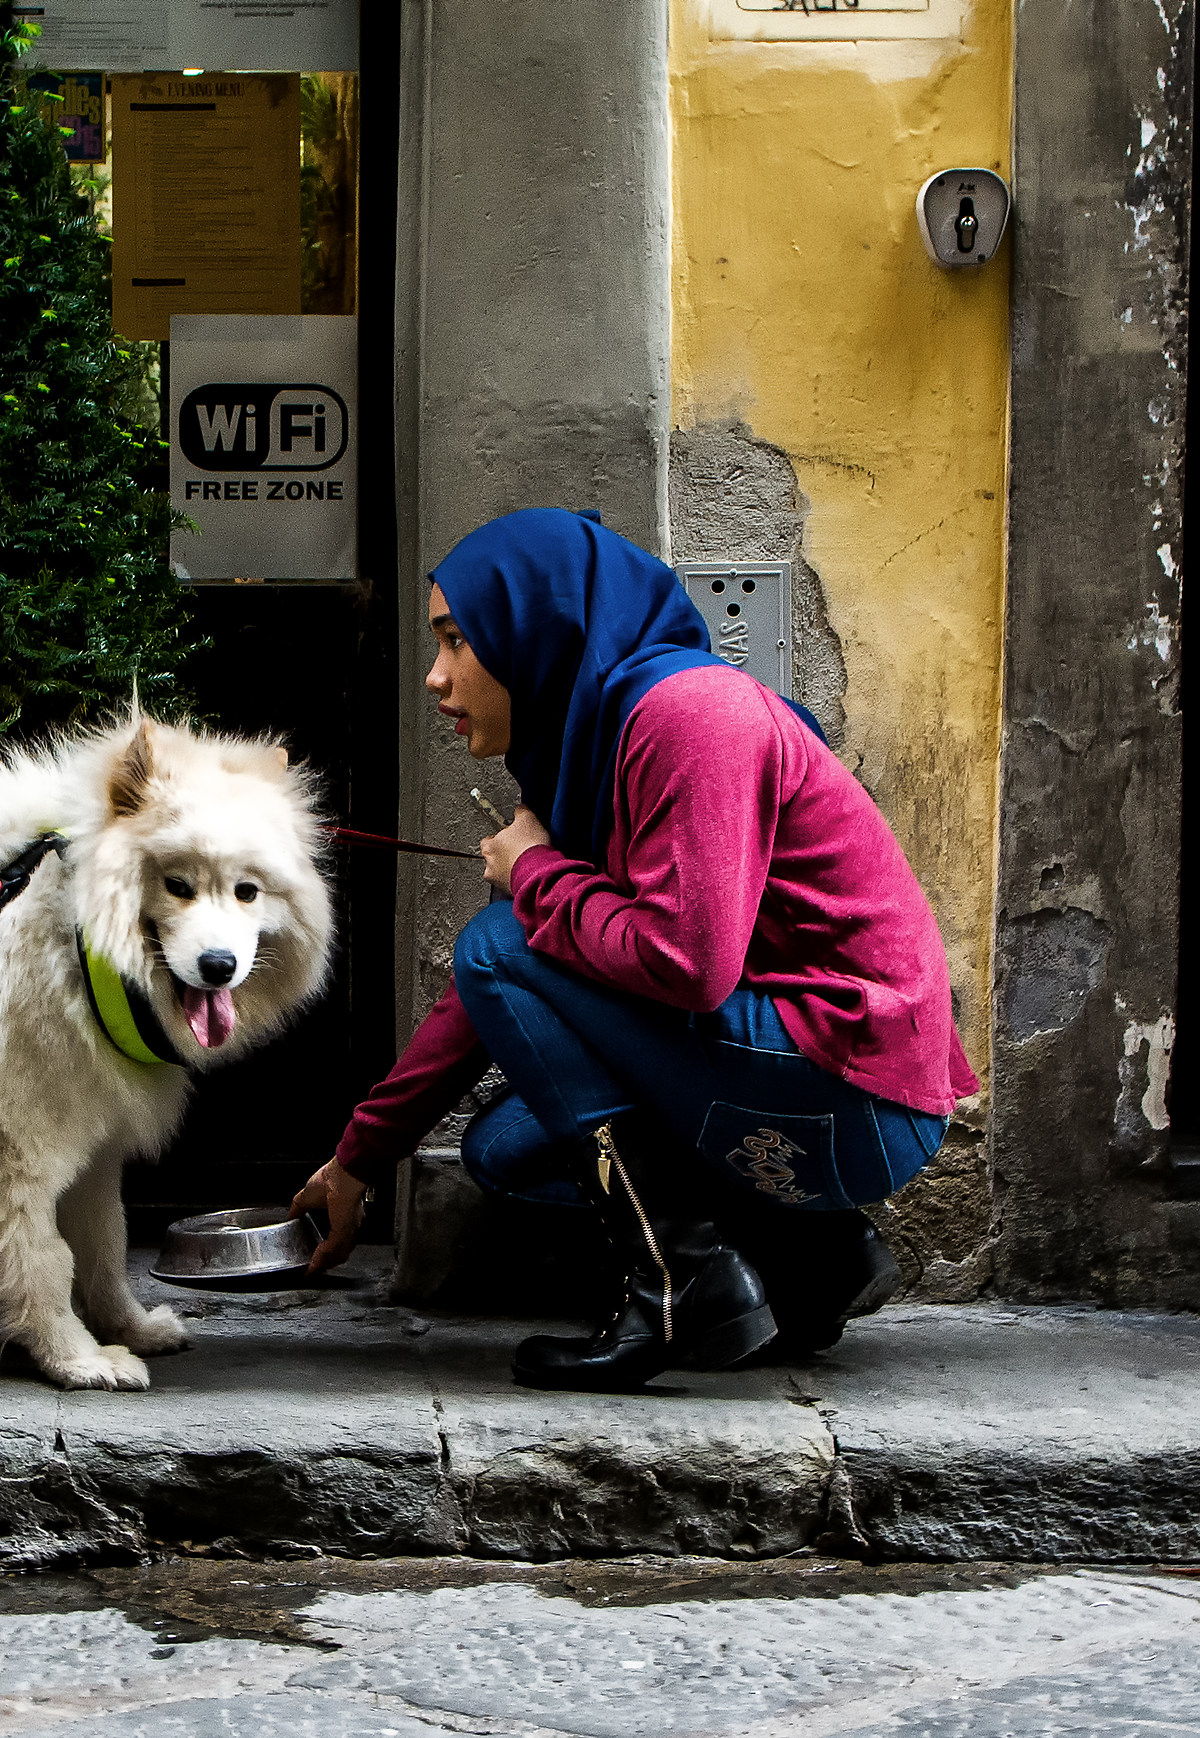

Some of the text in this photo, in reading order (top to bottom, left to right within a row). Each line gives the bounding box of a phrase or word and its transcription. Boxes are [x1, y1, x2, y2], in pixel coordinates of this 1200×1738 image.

[185, 481, 344, 501] FREE ZONE
[719, 621, 749, 666] GAS
